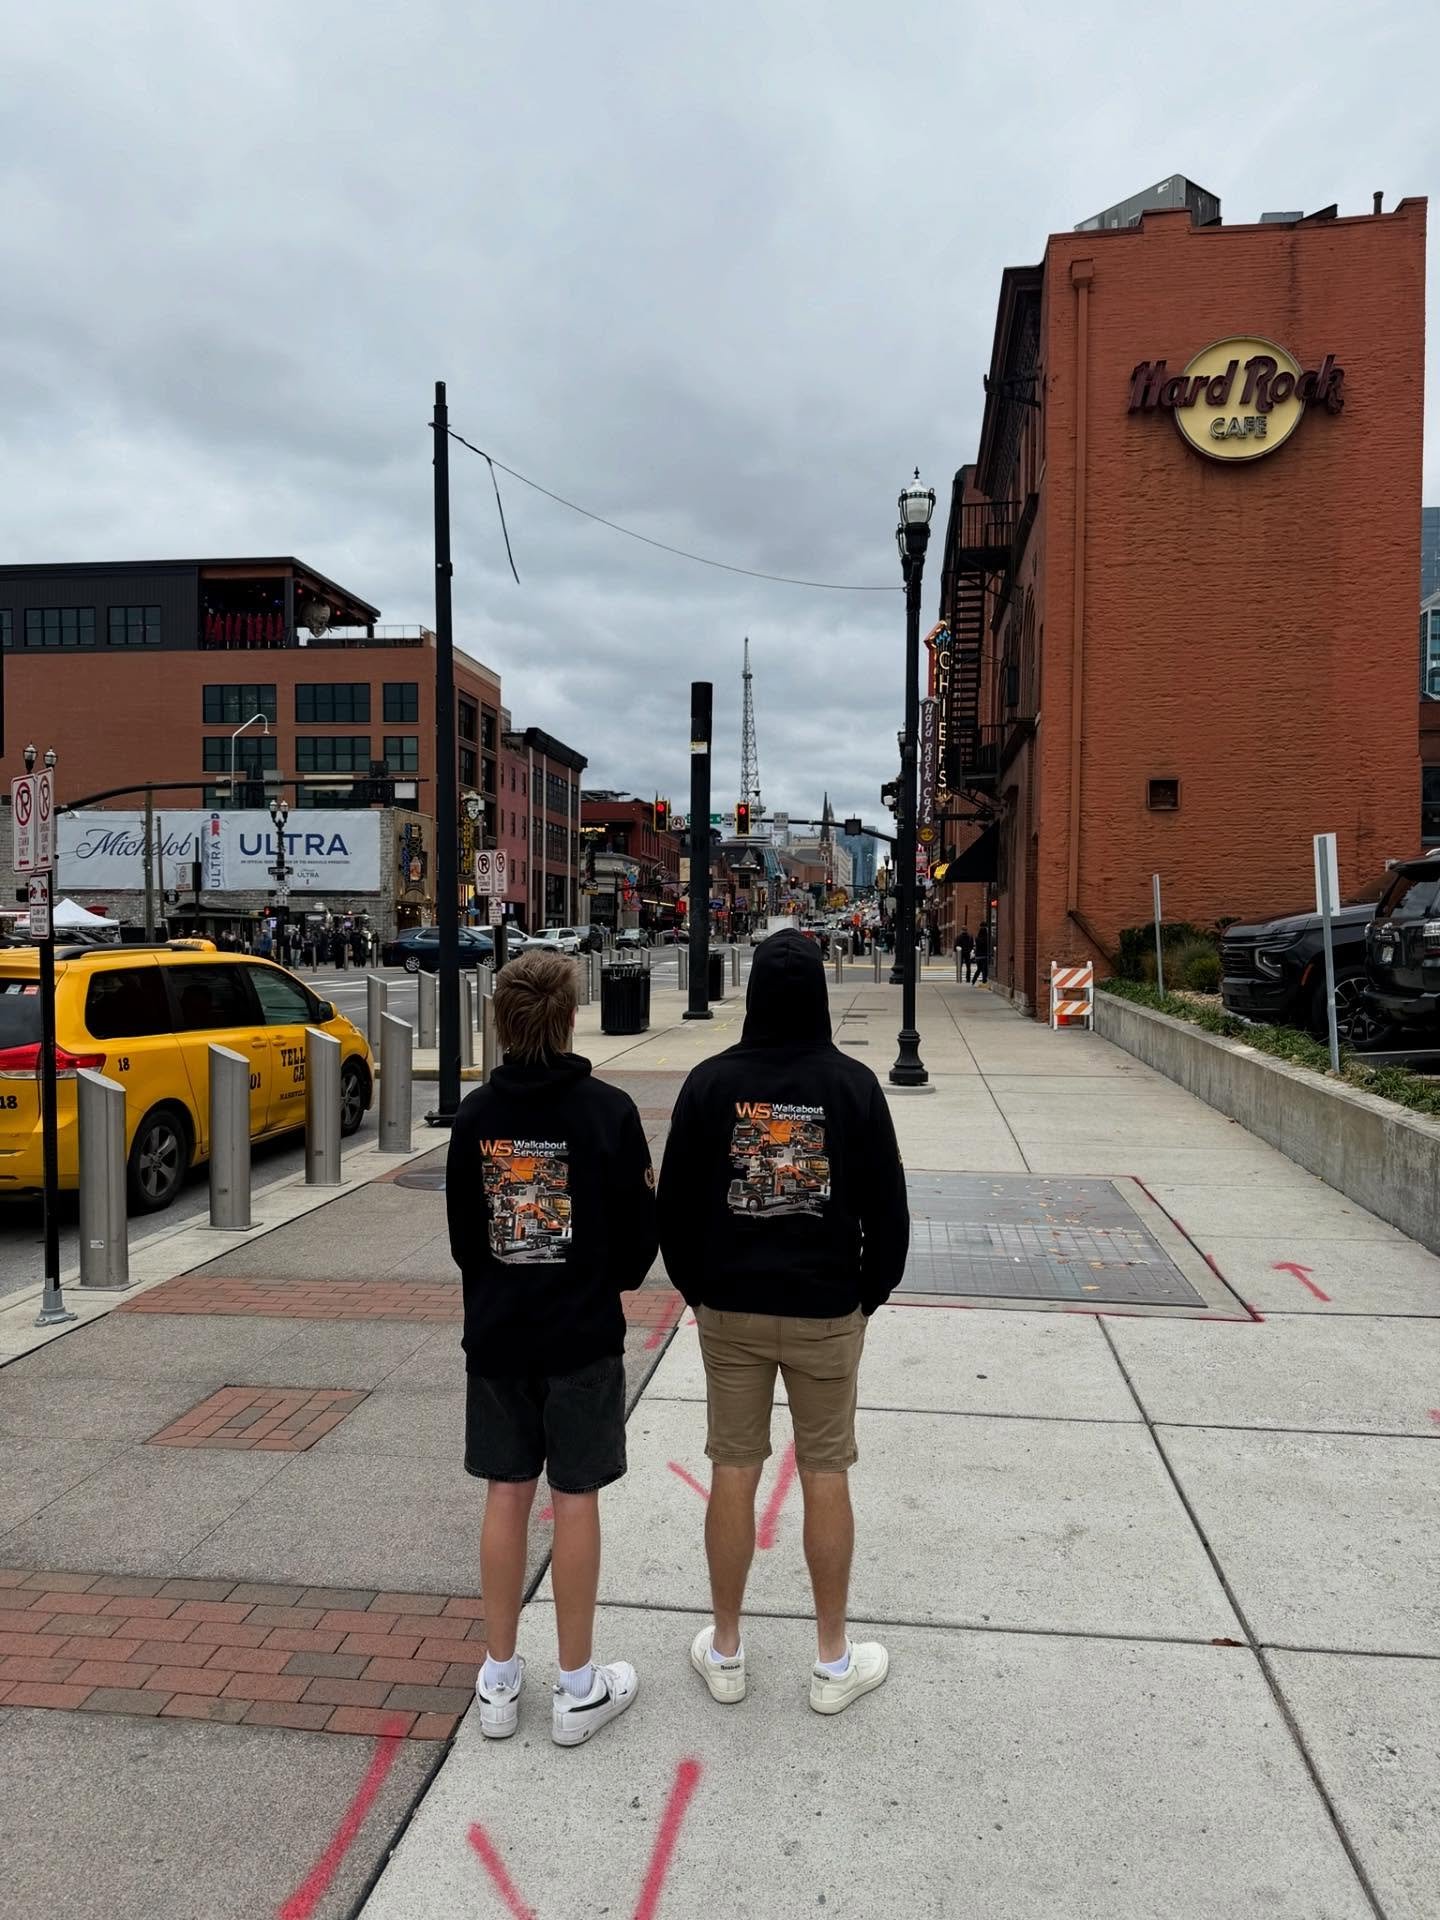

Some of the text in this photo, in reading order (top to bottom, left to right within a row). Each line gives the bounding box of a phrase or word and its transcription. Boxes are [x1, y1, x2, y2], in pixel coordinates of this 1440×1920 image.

[1127, 354, 1345, 415] Hard Rock
[1209, 416, 1267, 440] CAFE
[922, 703, 933, 824] Hard Rock Cafe
[76, 828, 193, 859] Michelob
[239, 833, 349, 856] ULTRA
[210, 840, 221, 888] ULTRA
[118, 1057, 130, 1072] 18
[280, 1046, 305, 1067] YELL
[293, 1064, 305, 1083] CA
[735, 1101, 772, 1119] WS
[771, 1112, 812, 1122] Services
[772, 1103, 824, 1115] Walkabout
[479, 1139, 513, 1157] WS
[513, 1140, 568, 1150] Walkabout
[513, 1149, 555, 1158] Services
